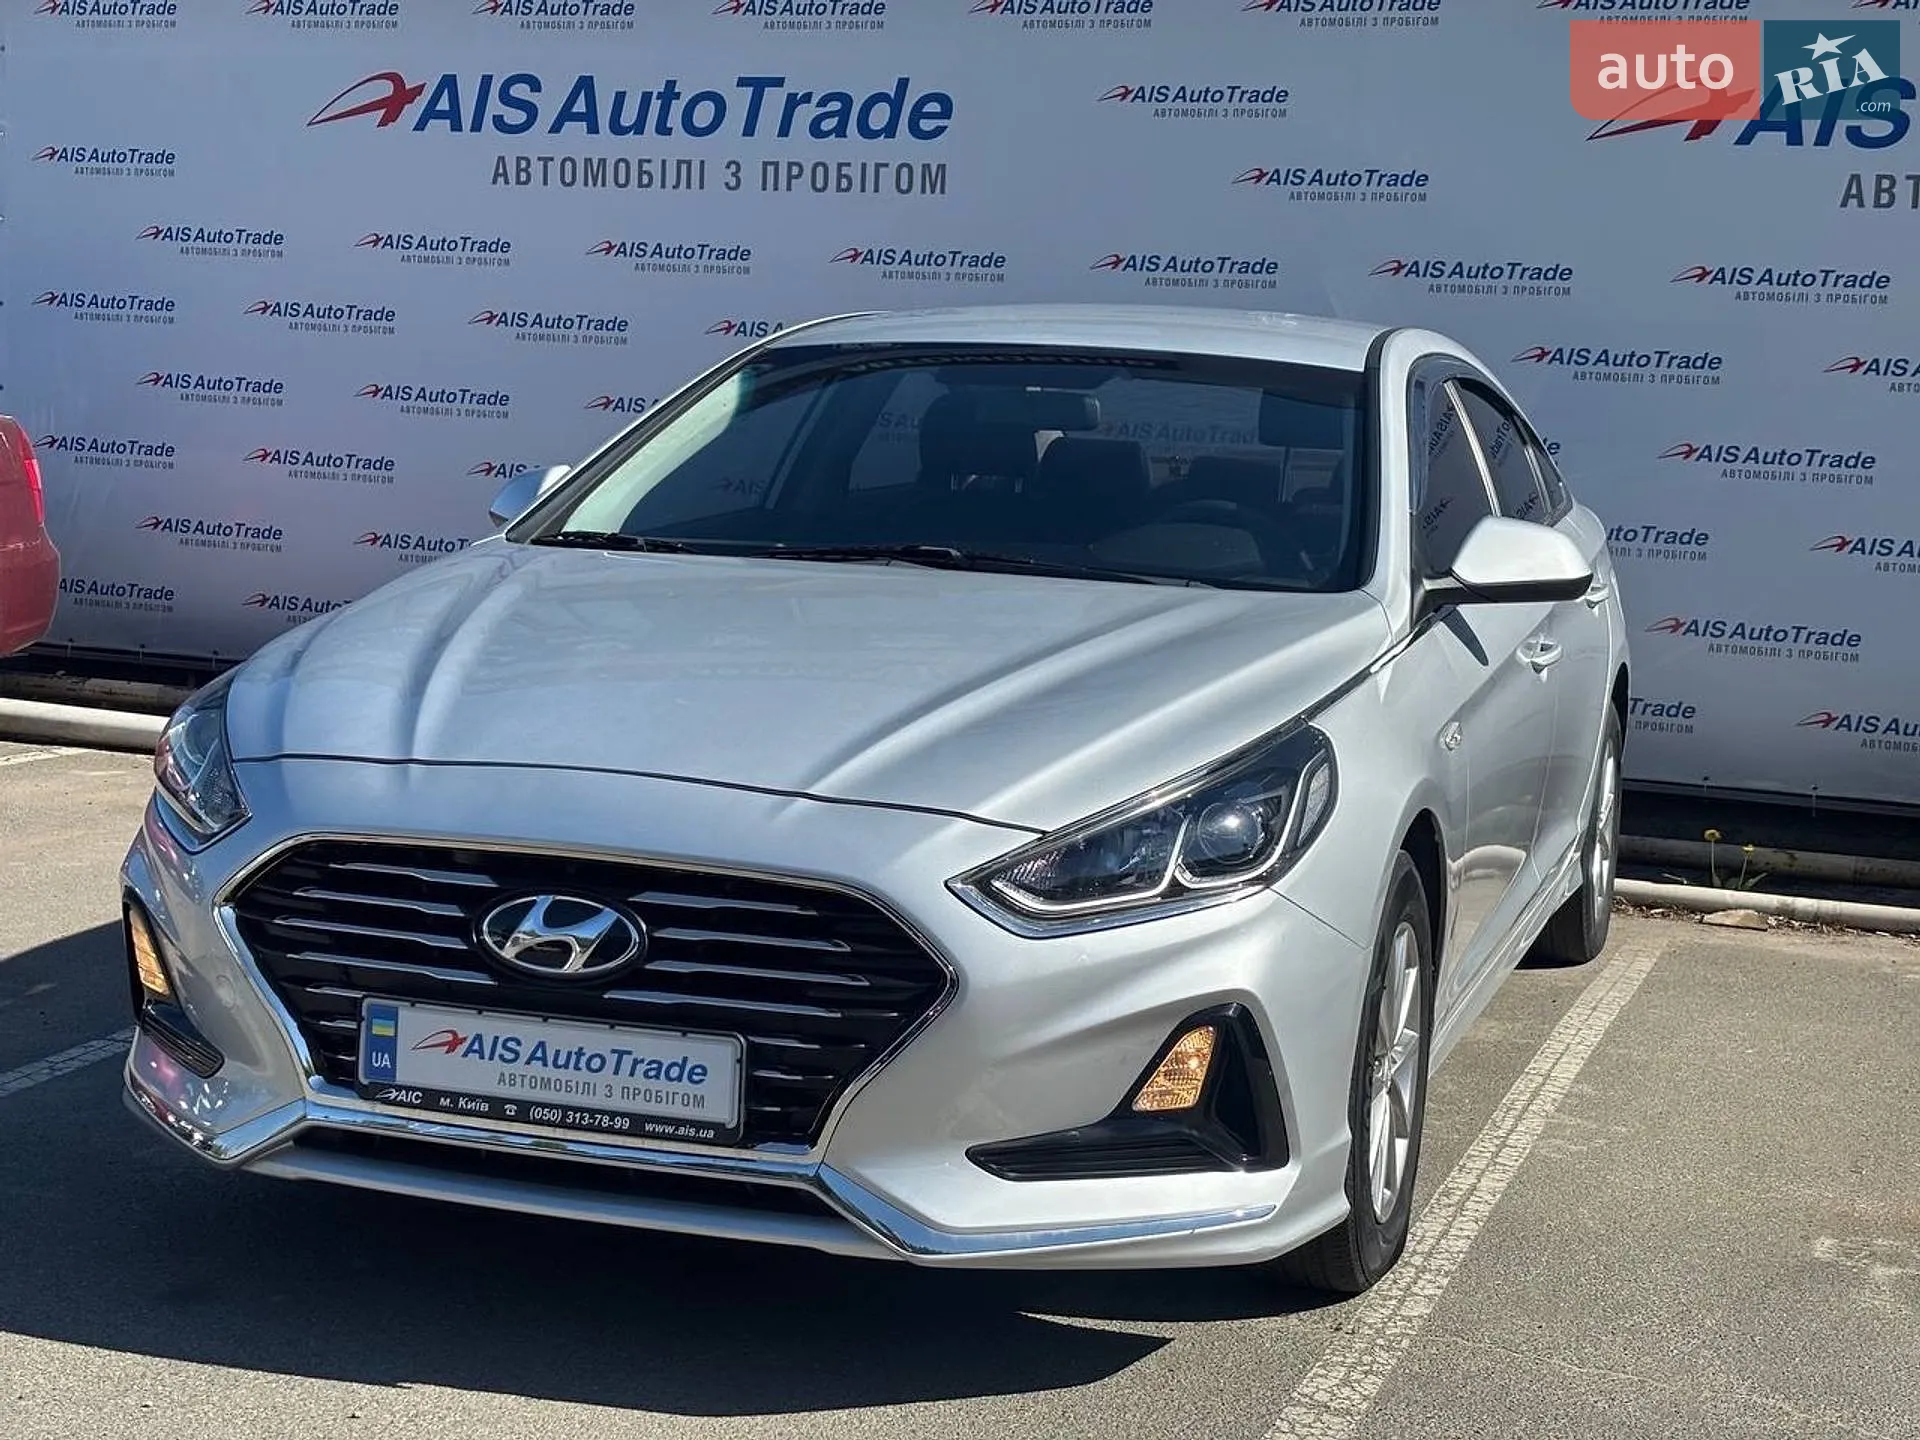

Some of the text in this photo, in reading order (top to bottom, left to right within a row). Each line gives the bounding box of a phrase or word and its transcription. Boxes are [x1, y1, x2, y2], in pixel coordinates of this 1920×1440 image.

[59, 0, 88, 15] AIS
[272, 0, 304, 15] AIS
[500, 0, 533, 15] AIS
[743, 0, 778, 16] AIS
[1000, 0, 1038, 15] AIS
[1131, 85, 1170, 103] AIS
[412, 73, 954, 141] AIS AutoTrade
[57, 147, 87, 163] AIS
[491, 155, 947, 195] АВТОМОБІЛІ З ПРОБІГОМ
[1265, 168, 1306, 186] AIS
[161, 226, 192, 242] AIS
[381, 234, 414, 250] AIS
[614, 242, 648, 258] AIS
[860, 248, 896, 266] AIS
[1122, 255, 1161, 273] AIS
[1404, 260, 1446, 280] AIS
[1708, 267, 1753, 286] AIS
[57, 292, 86, 309] AIS
[270, 302, 301, 319] AIS
[496, 312, 529, 329] AIS
[1548, 347, 1591, 367] AIS
[1862, 357, 1909, 377] AIS
[161, 373, 192, 390] AIS
[381, 384, 413, 402] AIS
[612, 397, 646, 413] AIS
[57, 436, 86, 452] AIS
[269, 450, 300, 466] AIS
[1695, 445, 1740, 465] AIS
[161, 517, 191, 534] AIS
[380, 533, 411, 550] AIS
[1848, 537, 1894, 557] AIS
[59, 578, 88, 596] AIS
[1681, 619, 1726, 641] AIS
[1834, 714, 1880, 733] AIS
[371, 1051, 392, 1069] UA
[461, 1033, 708, 1084] AIS AutoTrade
[497, 1072, 705, 1110] АВТОМОБІЛІ З ПРОБІГОМ
[458, 1097, 489, 1112] Київ
[529, 1105, 562, 1123] (050)
[566, 1111, 630, 1130] 313-78-99
[645, 1120, 715, 1139] www.ais.ua
